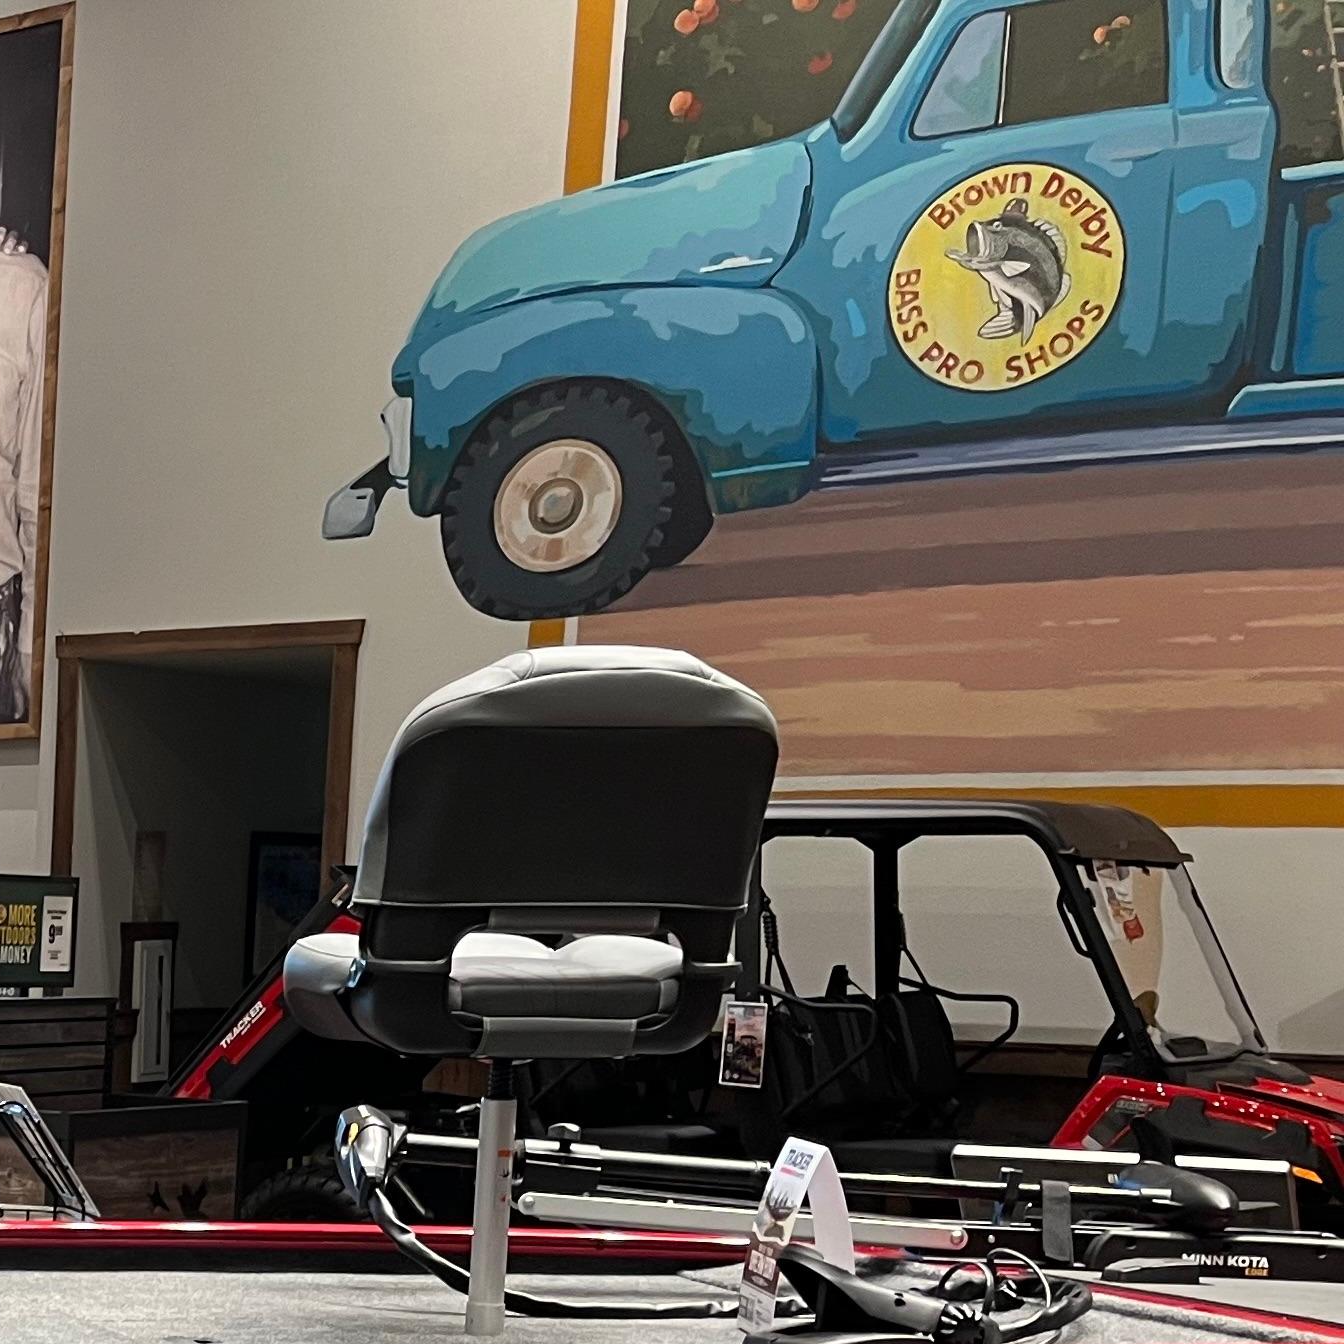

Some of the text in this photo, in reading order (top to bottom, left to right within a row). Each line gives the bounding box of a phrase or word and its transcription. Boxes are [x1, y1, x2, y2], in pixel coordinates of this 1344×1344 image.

[927, 170, 1113, 258] Brown Derby
[895, 268, 1105, 384] BASS PRO SHOPS
[8, 903, 38, 927] MORE
[0, 945, 34, 964] MONEY
[219, 1000, 264, 1049] TRACKER
[1227, 1254, 1269, 1268] KOTA
